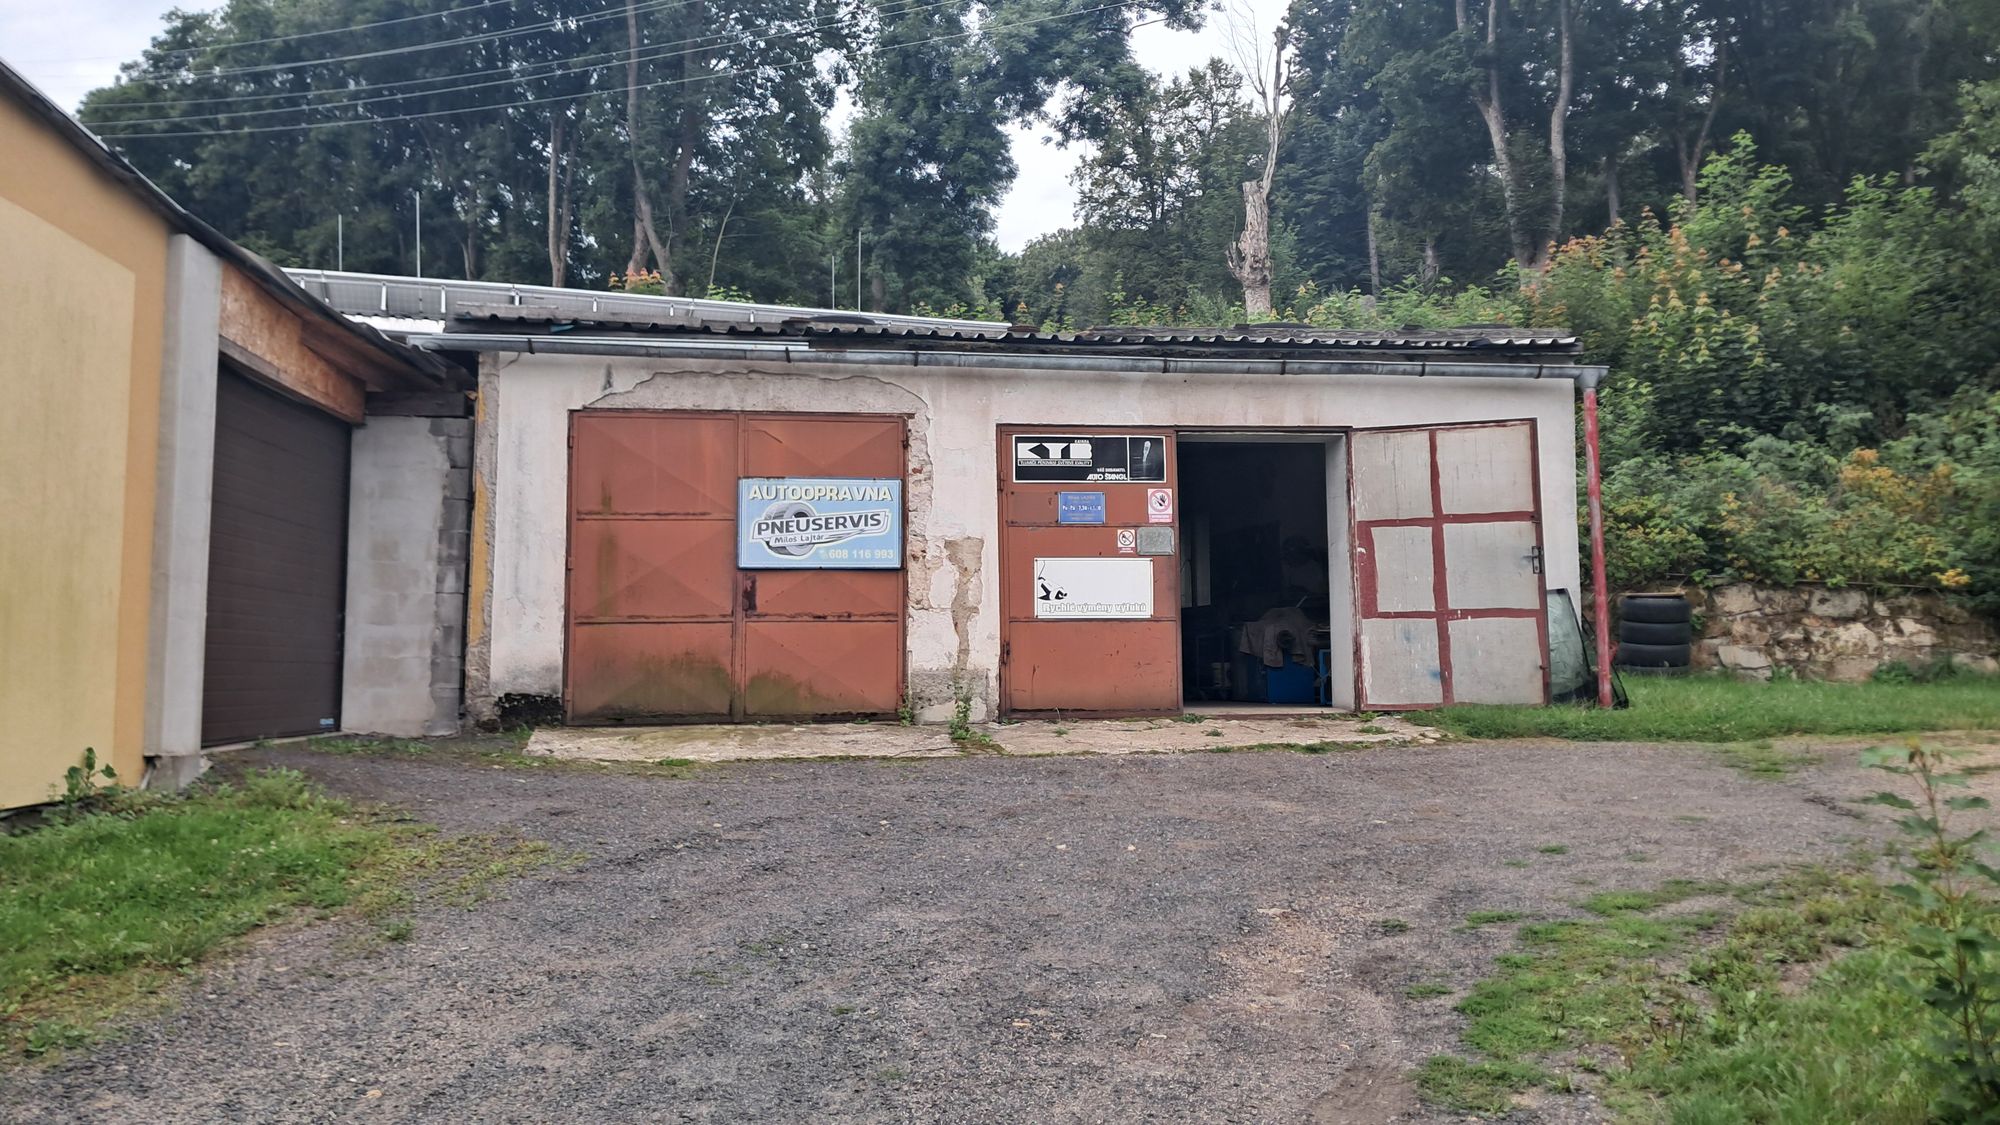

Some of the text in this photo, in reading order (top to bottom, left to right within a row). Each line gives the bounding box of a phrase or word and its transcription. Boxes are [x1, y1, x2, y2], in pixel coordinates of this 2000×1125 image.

[1017, 442, 1093, 459] KYB
[1086, 472, 1127, 481] AUTO ŠTANGL
[749, 485, 893, 501] AUTOOPRAVNA
[757, 513, 882, 536] PNEUSERVIS
[774, 535, 798, 544] Miloš
[829, 549, 894, 559] 608 116 993
[1041, 602, 1076, 613] Rychlé
[1077, 602, 1113, 613] výměny
